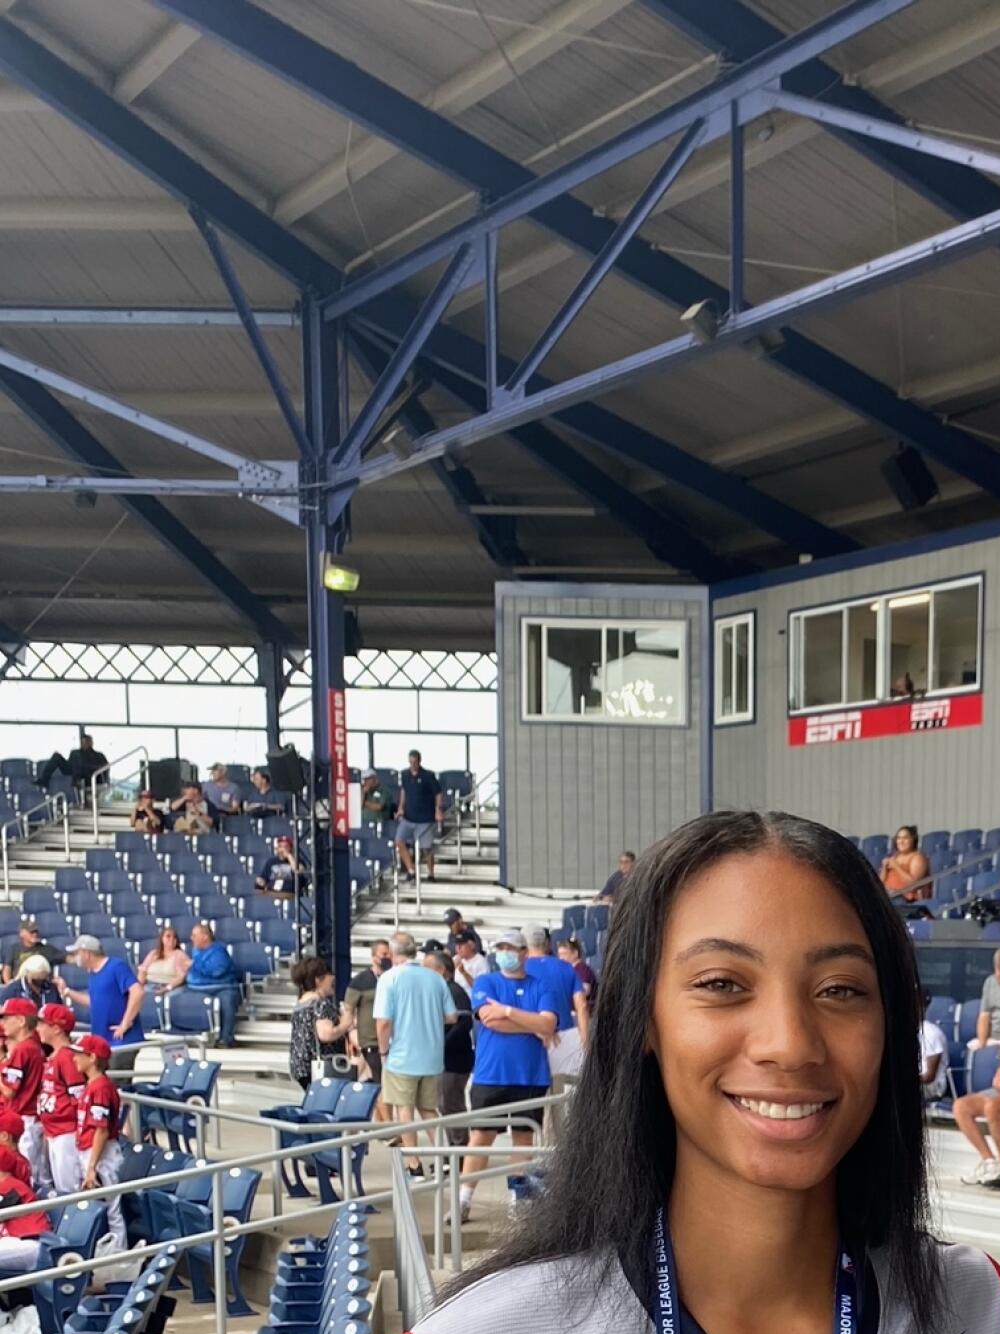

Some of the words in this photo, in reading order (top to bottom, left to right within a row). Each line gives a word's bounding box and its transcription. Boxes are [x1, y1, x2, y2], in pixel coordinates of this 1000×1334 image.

[910, 699, 950, 721] ESPN
[806, 711, 862, 743] ESPN
[334, 691, 346, 811] SECTION
[335, 817, 346, 834] 4
[657, 1265, 673, 1315] LEAGUE
